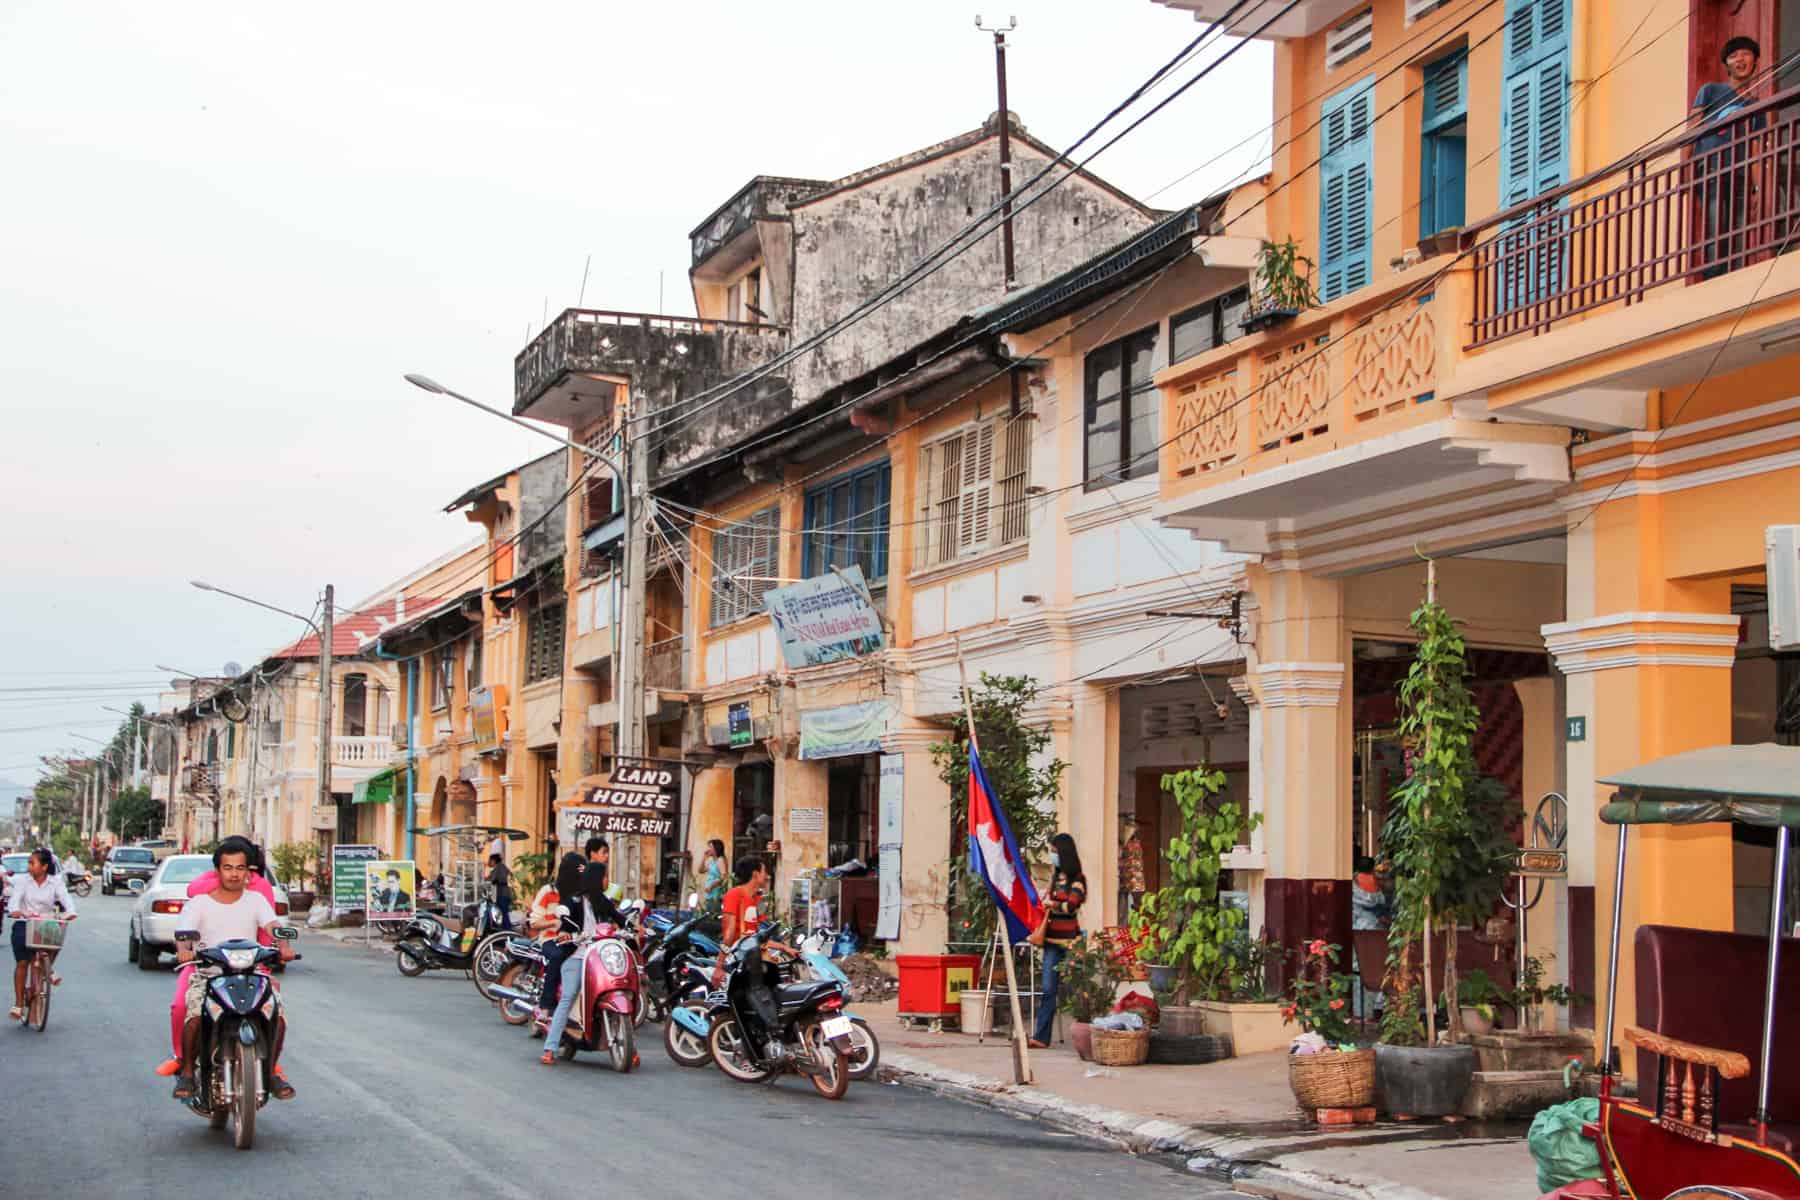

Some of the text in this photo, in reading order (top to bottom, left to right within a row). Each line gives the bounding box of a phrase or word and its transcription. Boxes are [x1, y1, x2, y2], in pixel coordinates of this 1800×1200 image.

[1570, 721, 1581, 737] 16
[617, 768, 673, 785] LAND
[592, 789, 671, 809] HOUSE
[576, 814, 601, 830] FOR
